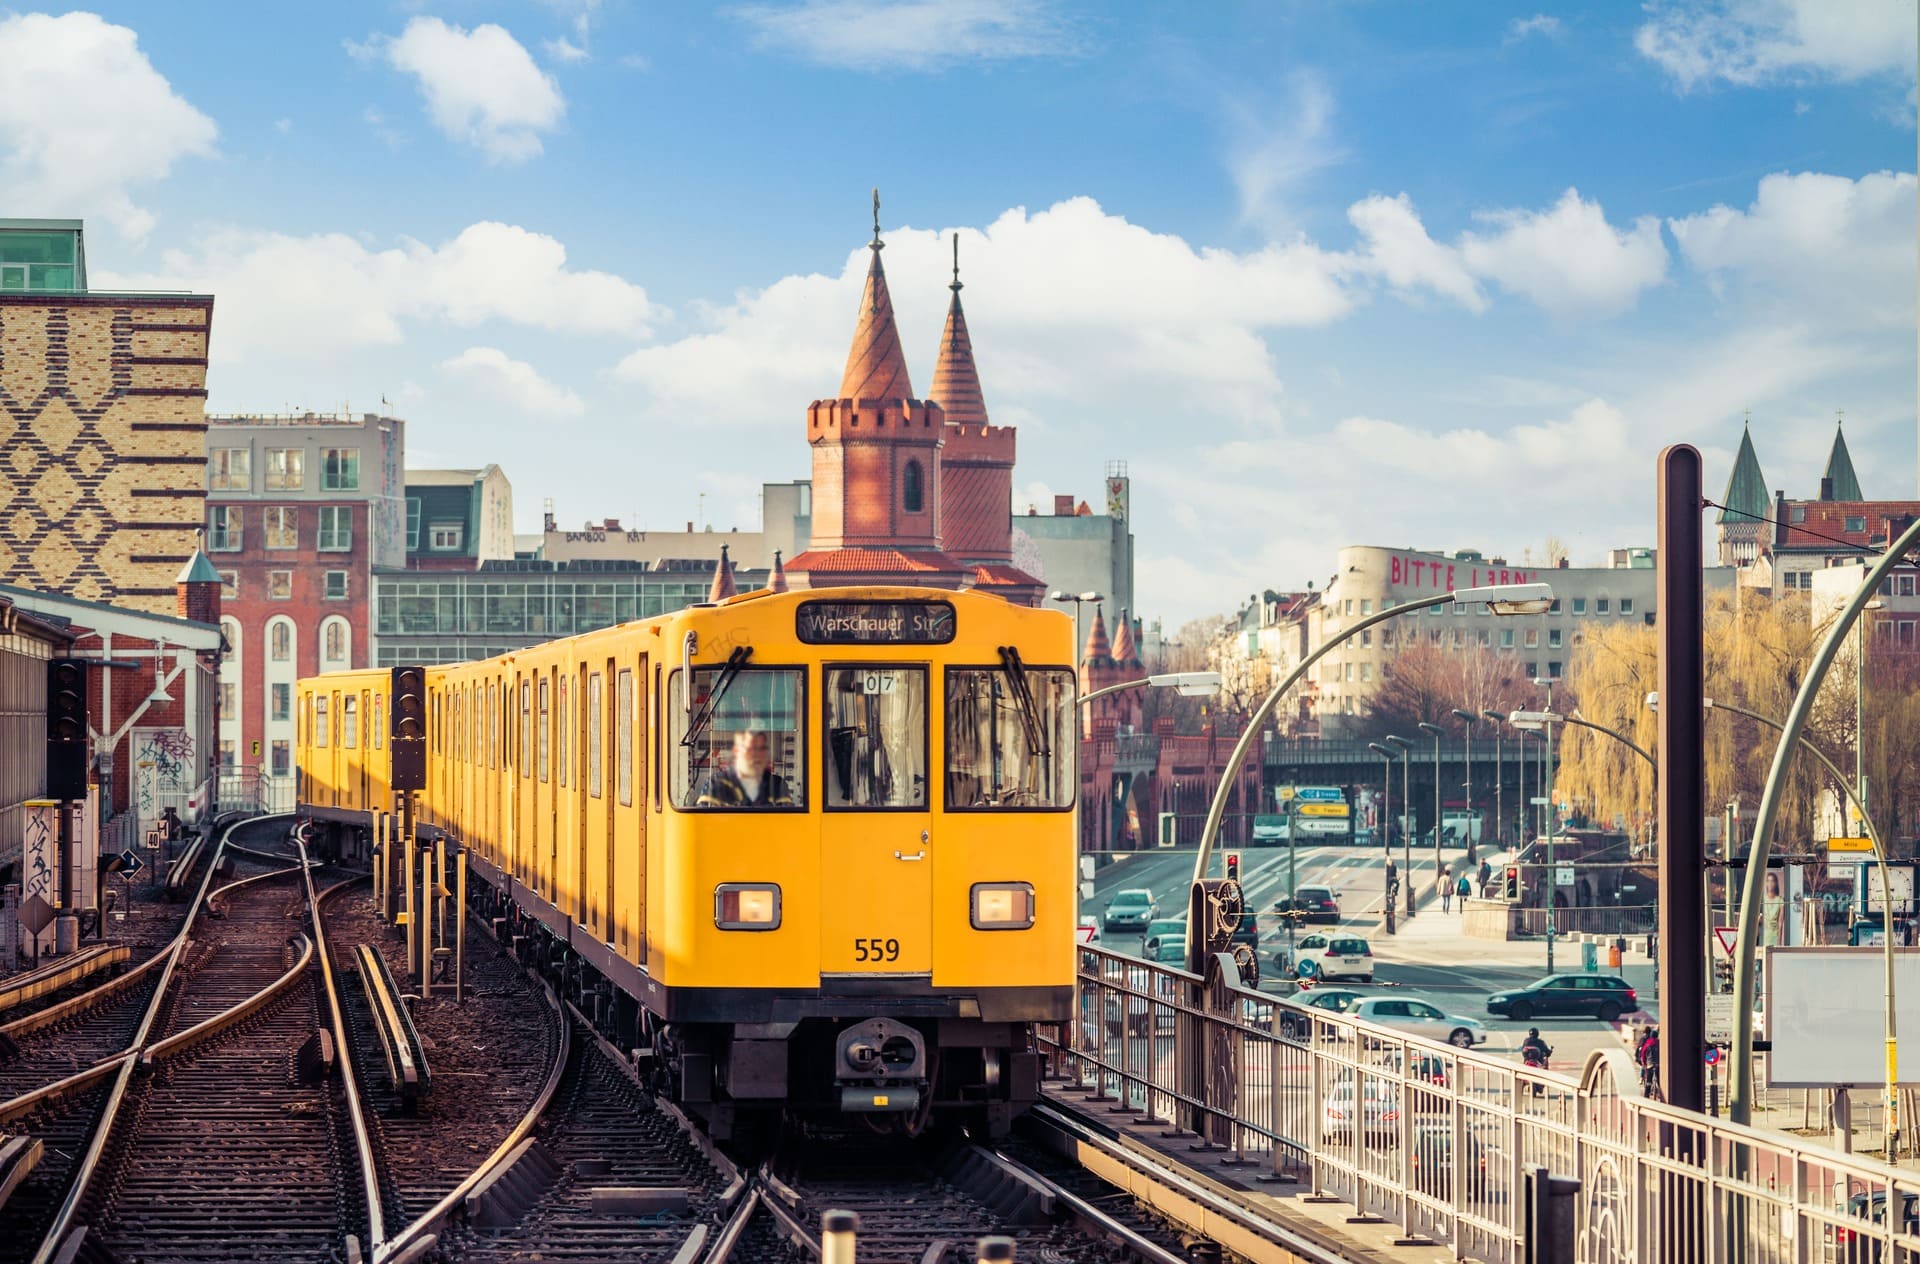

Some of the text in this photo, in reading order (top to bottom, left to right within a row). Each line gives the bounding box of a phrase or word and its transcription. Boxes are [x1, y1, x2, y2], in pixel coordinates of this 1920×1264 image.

[566, 532, 606, 543] BAMBOO
[1391, 556, 1456, 592] BITTE
[810, 615, 904, 631] Warschauer
[253, 741, 259, 754] F
[149, 833, 158, 847] 40
[855, 938, 900, 962] 559
